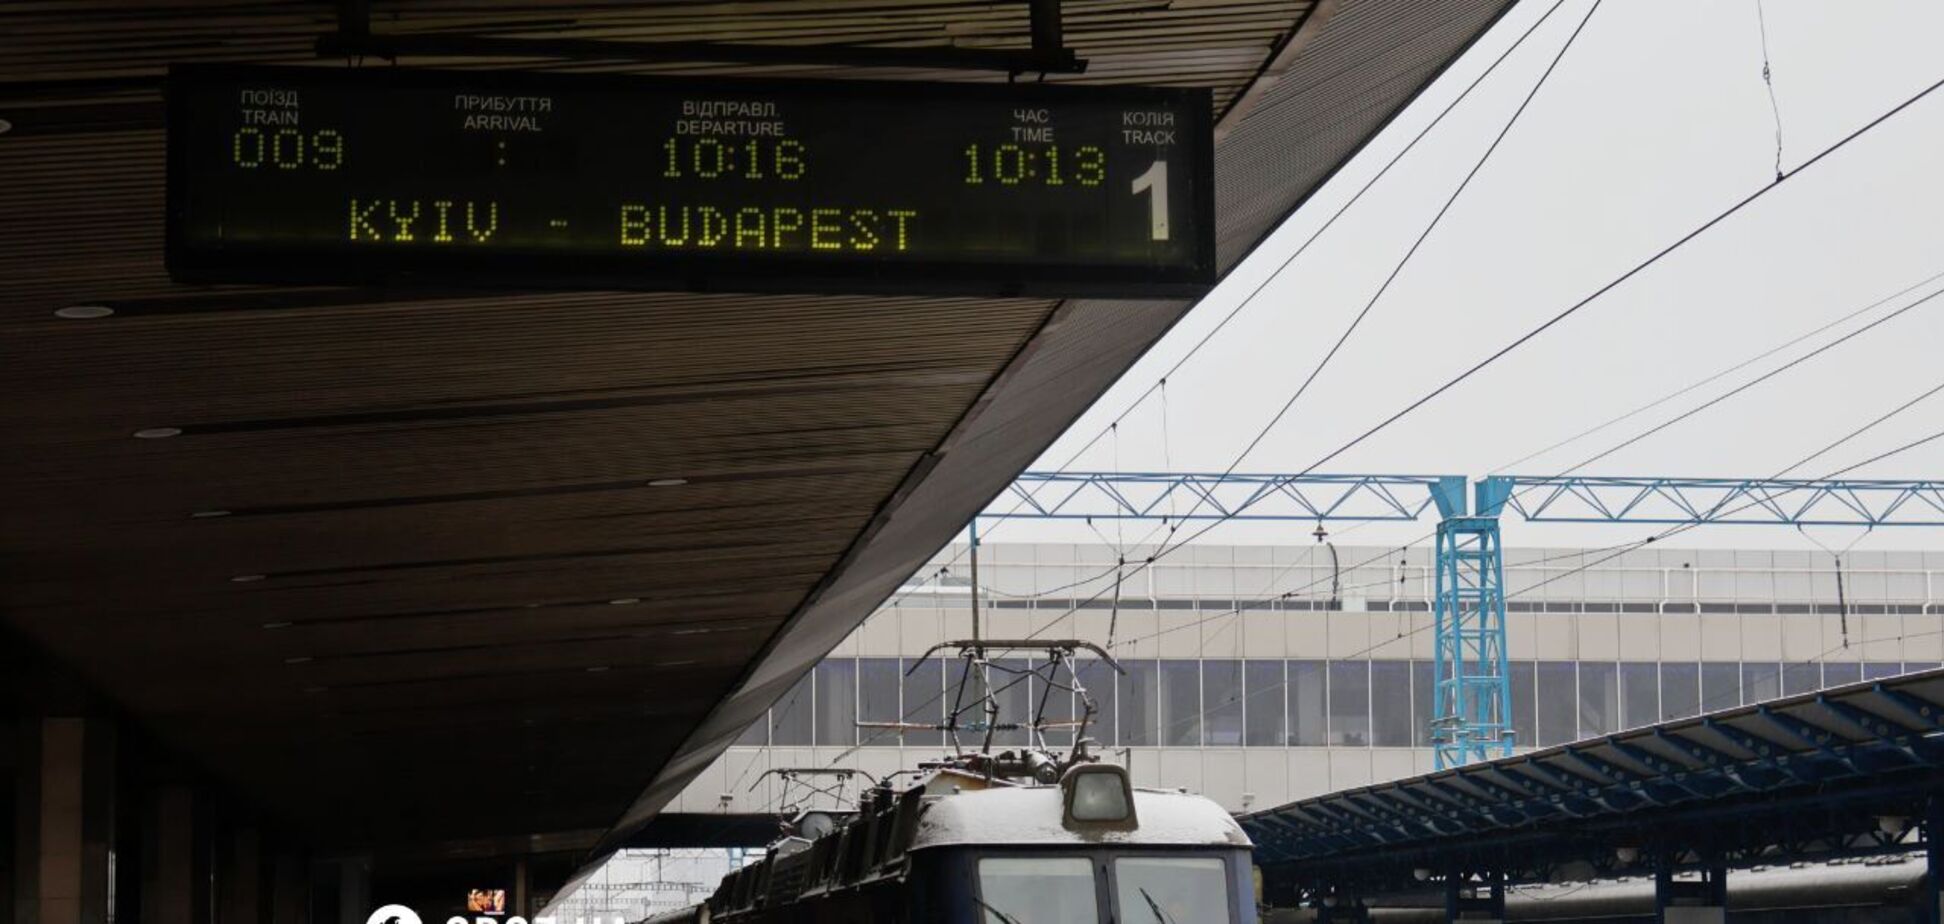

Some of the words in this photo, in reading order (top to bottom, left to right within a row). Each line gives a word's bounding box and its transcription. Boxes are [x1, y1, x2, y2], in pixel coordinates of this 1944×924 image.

[241, 89, 299, 108] ПОЇЗД
[455, 95, 552, 113] ПРИБУТТЯ
[242, 109, 299, 126] TRAIN
[683, 101, 780, 118] ВІДПРАВЛ.
[1013, 108, 1050, 124] ЧАС
[464, 115, 542, 131] ARRIVAL
[1123, 111, 1175, 126] КОЛІЯ
[676, 120, 784, 136] DEPARTURE
[1012, 127, 1054, 142] TIME
[1123, 130, 1176, 145] TRACK
[234, 127, 343, 170] 009
[663, 137, 806, 178] 10:16
[965, 143, 1105, 184] 10:13
[1131, 160, 1170, 241] 1
[350, 199, 498, 242] KYIV
[620, 204, 917, 251] BUDAPEST
